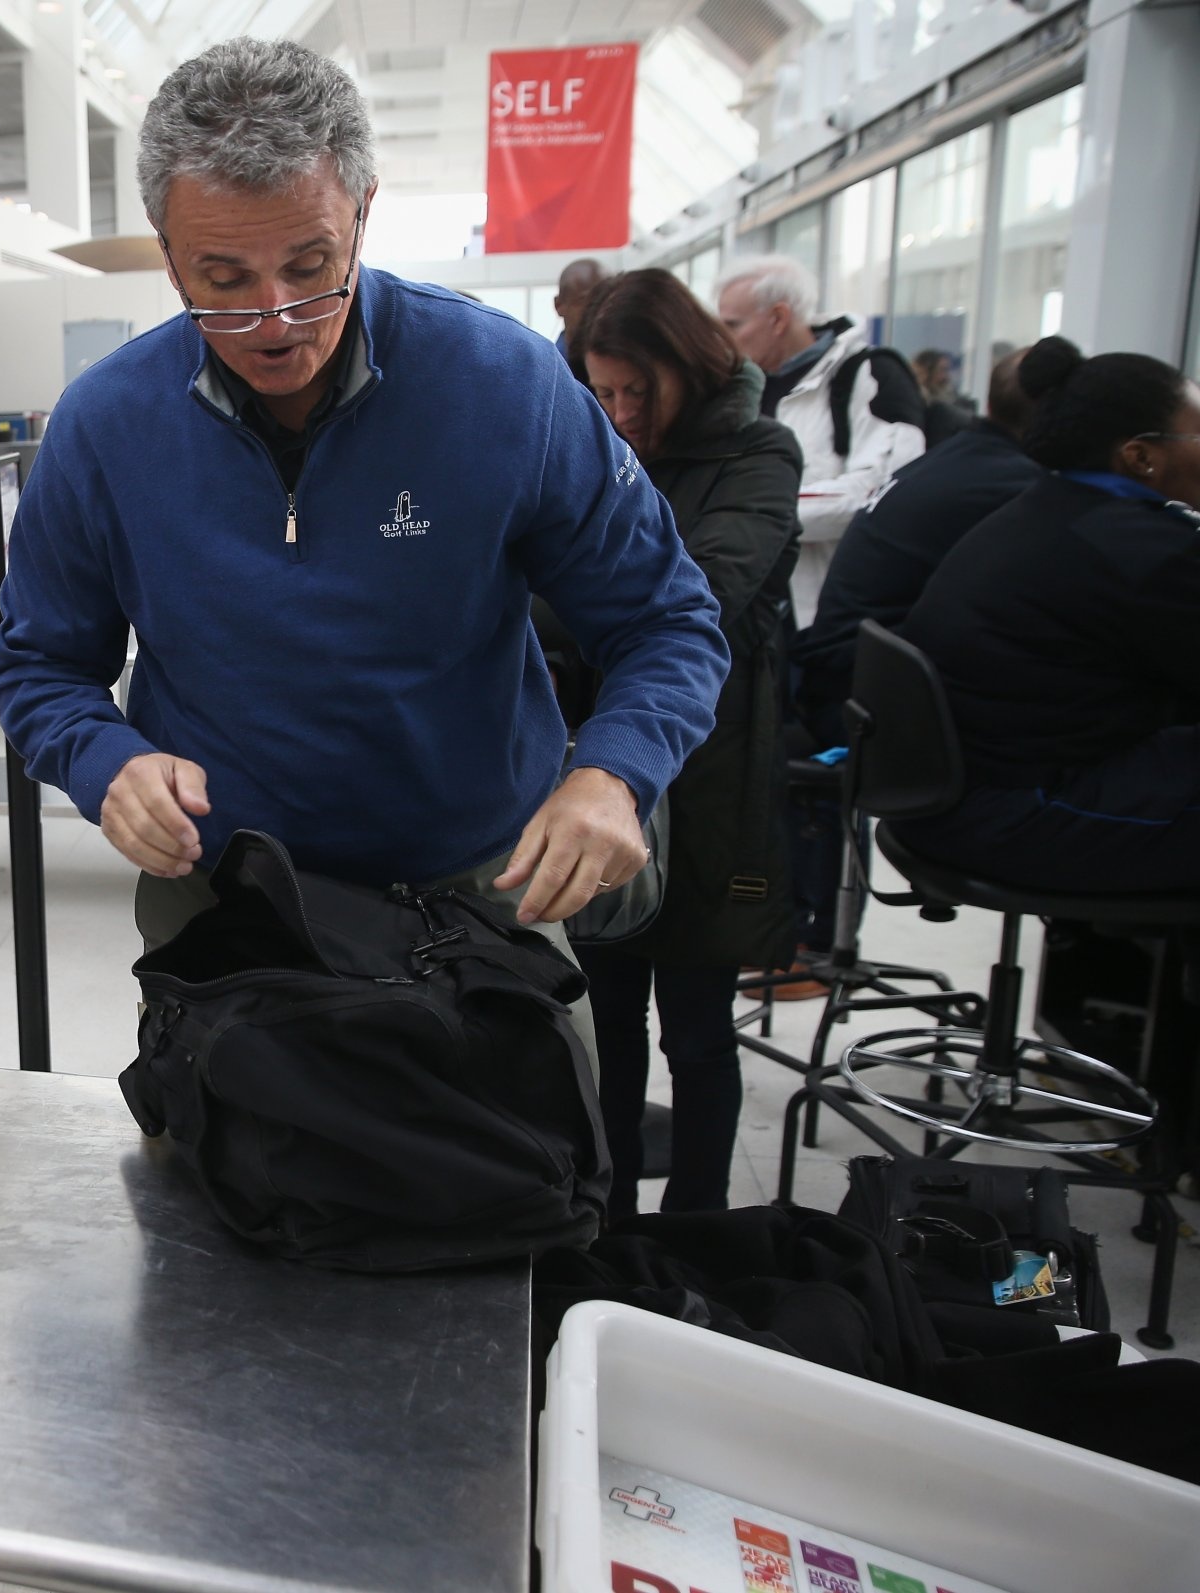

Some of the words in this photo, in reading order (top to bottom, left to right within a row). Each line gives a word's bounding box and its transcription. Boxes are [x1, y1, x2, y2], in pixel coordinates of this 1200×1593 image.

[492, 77, 585, 118] SELF
[379, 523, 399, 532] OLD
[402, 520, 431, 531] HEAD
[383, 530, 402, 538] Golf
[405, 528, 427, 537] Links
[616, 1491, 657, 1511] URGENT
[740, 1544, 791, 1568] HEAD
[742, 1552, 792, 1577] ACHE
[808, 1566, 859, 1593] HEART
